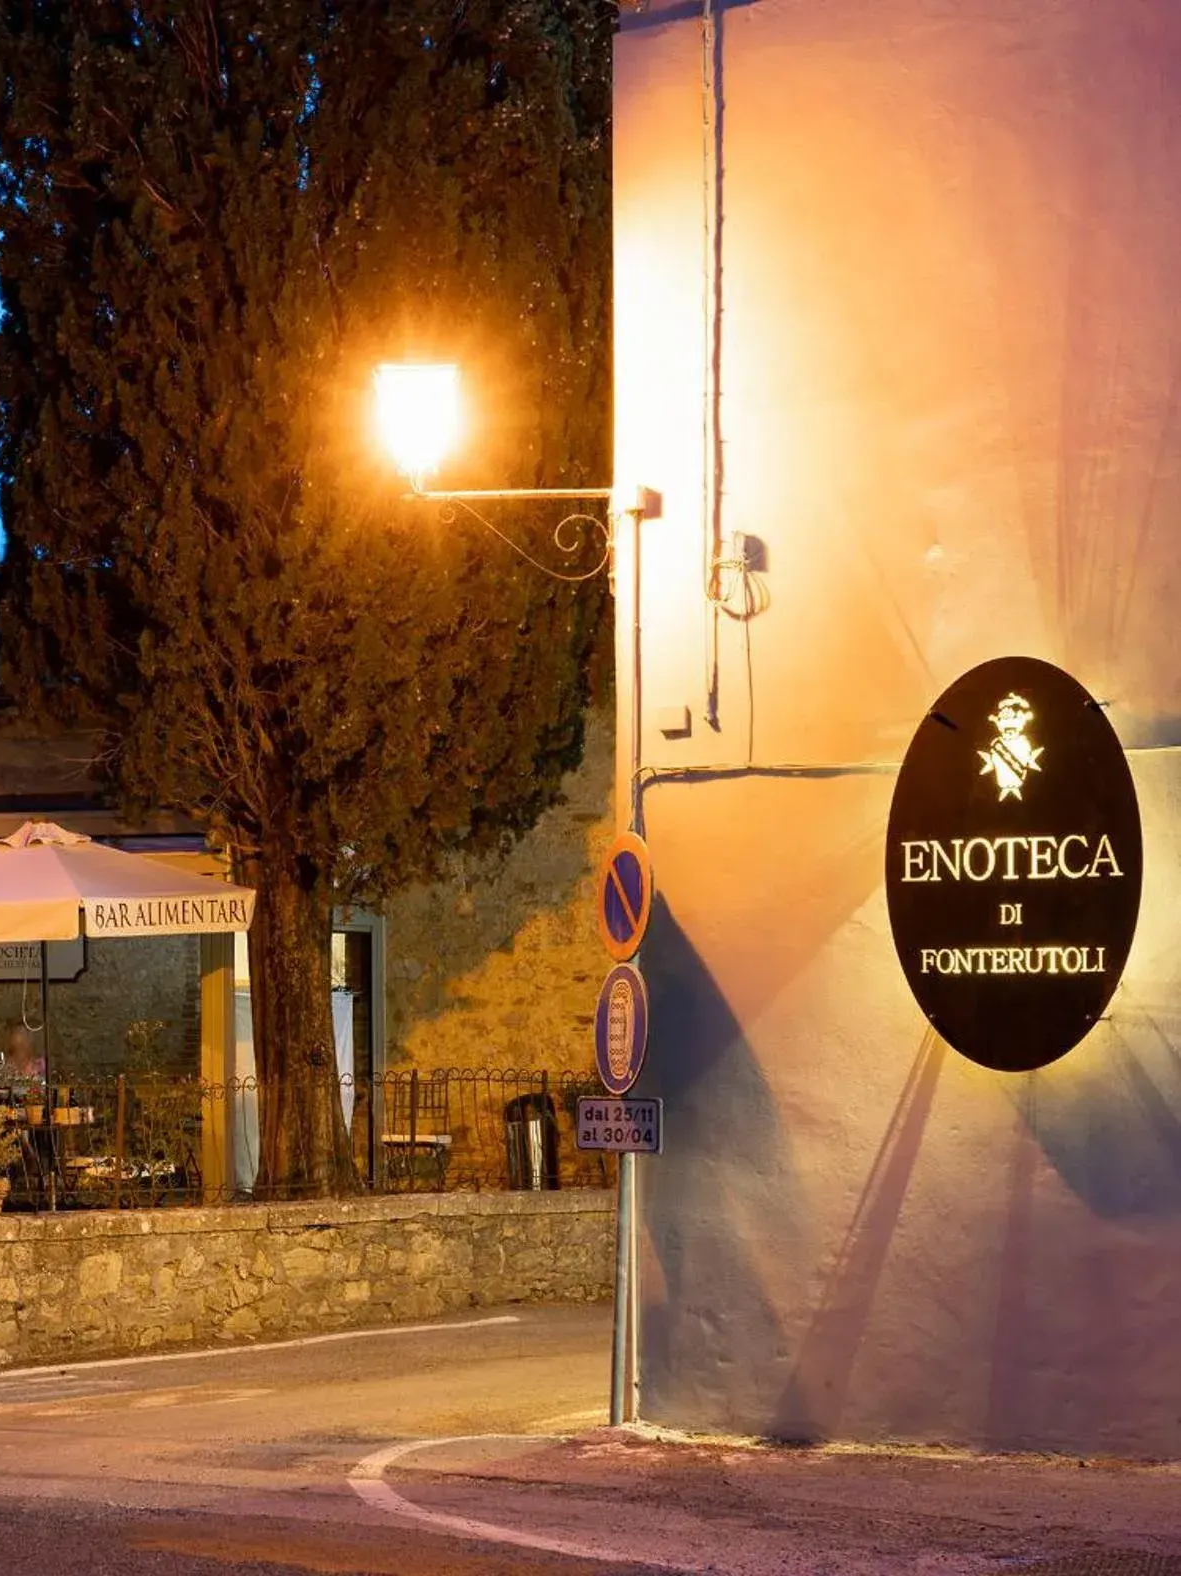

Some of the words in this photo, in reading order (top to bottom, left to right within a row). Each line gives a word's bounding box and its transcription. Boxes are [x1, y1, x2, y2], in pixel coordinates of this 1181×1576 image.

[900, 834, 1124, 882] ENOTECA
[95, 902, 132, 930] BAR
[134, 899, 248, 926] ALIMENTARI
[999, 903, 1023, 925] DI
[920, 946, 1106, 975] FONTERUTOLI
[585, 1106, 609, 1122] dal
[614, 1106, 653, 1123] 25/11
[582, 1127, 597, 1142] al
[603, 1127, 653, 1144] 30/04
